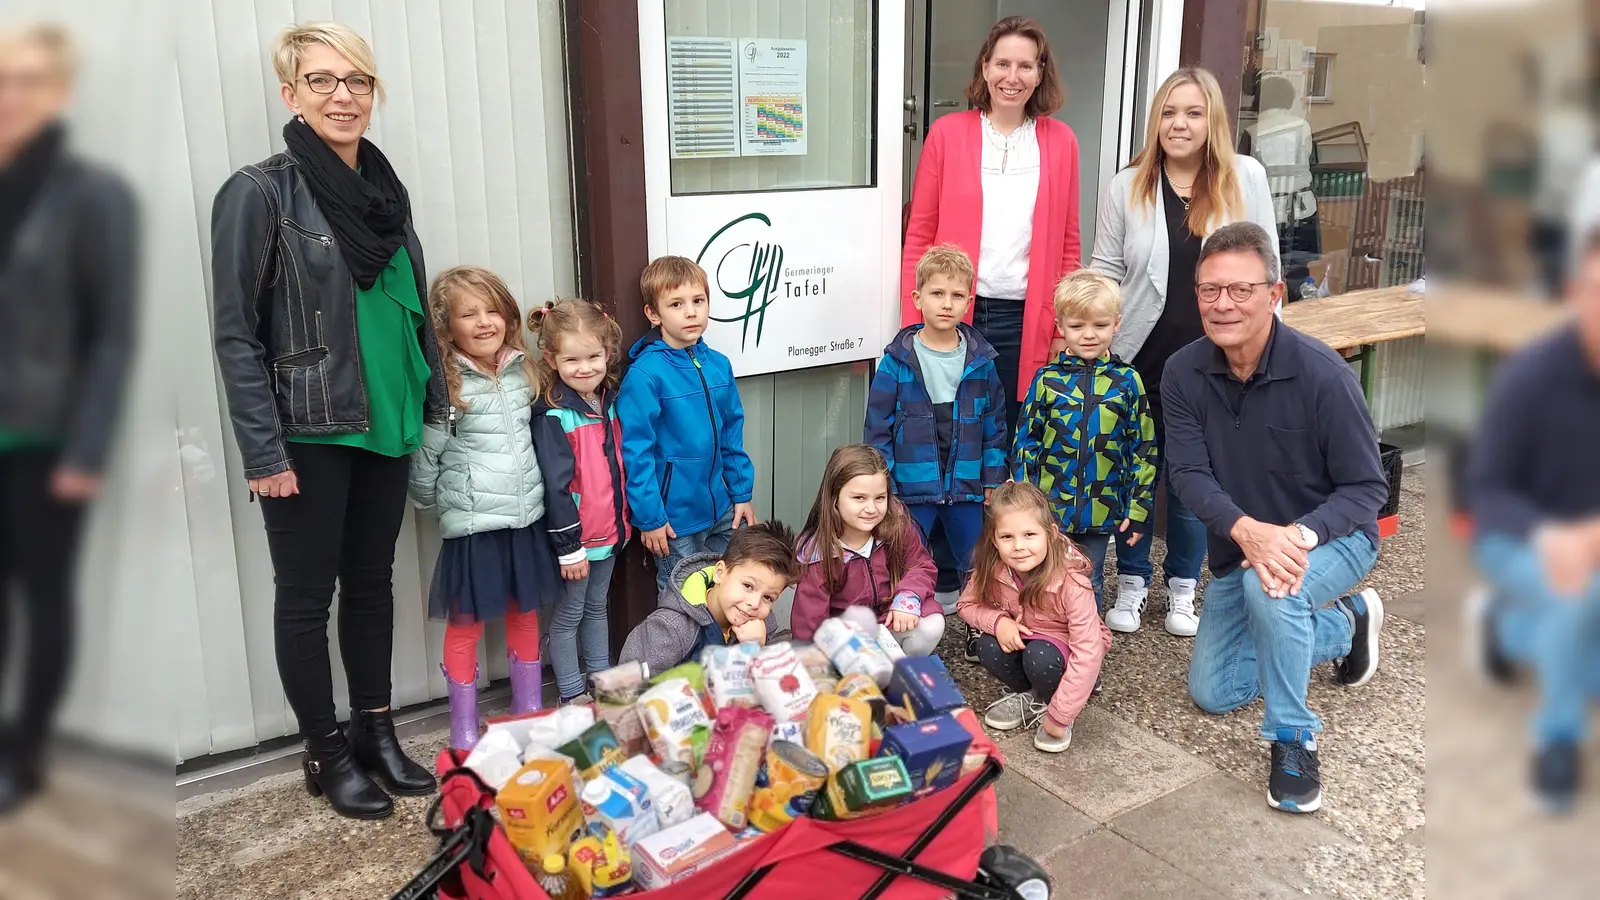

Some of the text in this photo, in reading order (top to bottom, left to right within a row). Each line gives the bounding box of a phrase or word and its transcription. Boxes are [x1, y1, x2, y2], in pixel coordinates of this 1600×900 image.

[785, 265, 834, 278] Germeringer
[784, 278, 826, 298] Tafel
[788, 337, 864, 357] Planegger Straße 7
